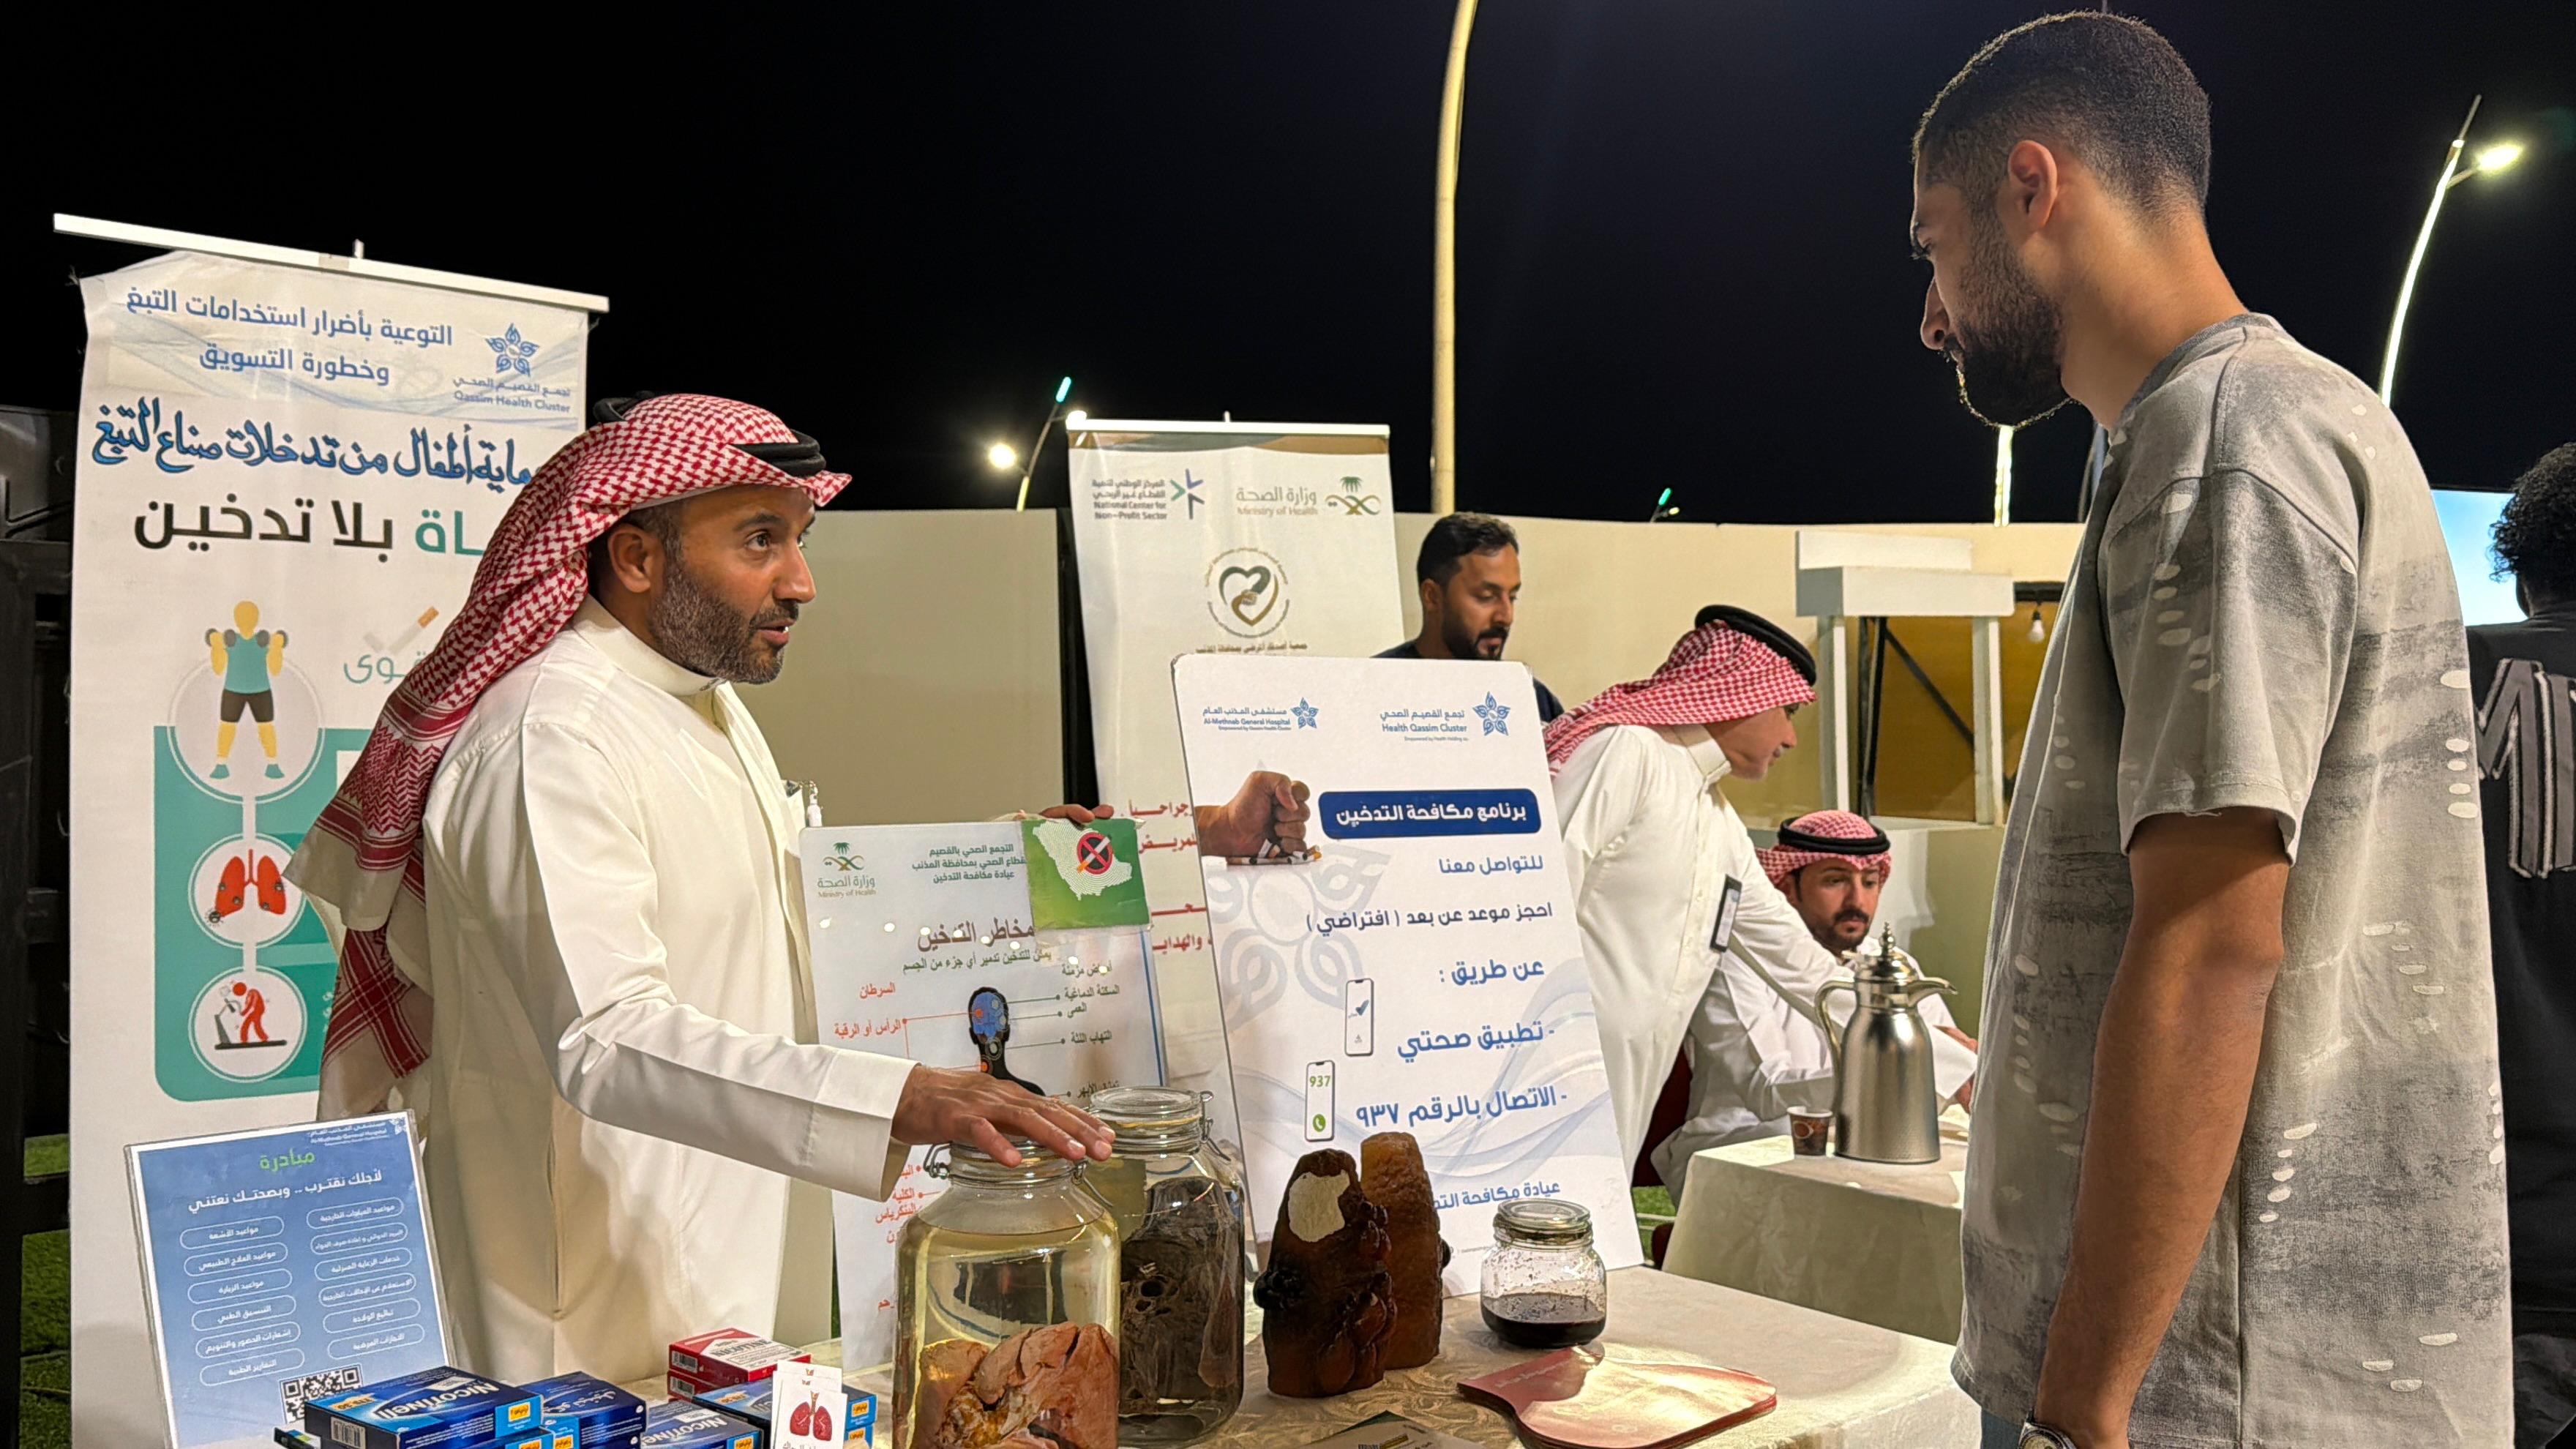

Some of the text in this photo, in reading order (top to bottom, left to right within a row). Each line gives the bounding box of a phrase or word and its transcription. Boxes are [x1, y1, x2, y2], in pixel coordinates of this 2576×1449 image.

[127, 287, 452, 348] التوعية بأضرار استخدامات التبغ
[199, 342, 389, 386] وخطورة التسويق
[454, 390, 571, 413] Qassim Health Cluster
[92, 397, 160, 465] التبغ
[155, 411, 222, 473] صناع
[225, 419, 340, 468] تدخلات
[339, 441, 388, 475] من
[472, 438, 532, 494] ماية
[1236, 486, 1317, 506] وزارة الصحة
[1142, 512, 1167, 520] Sector
[1238, 506, 1318, 517] Ministry of Health
[135, 493, 315, 551] تدخين
[332, 500, 393, 563] بلا
[1380, 708, 1465, 722] تجمع القصيم الصحي
[1382, 723, 1467, 733] Health Qassim Cluster
[1336, 802, 1527, 828] برنامج مكافحة التدخين
[929, 844, 1014, 858] التجمع الصحي بالقصيم
[912, 859, 940, 869] المذنب
[943, 858, 977, 868] بمحافظة
[979, 857, 1004, 868] الصحي
[1439, 855, 1543, 876] للتواصل معنا
[817, 876, 875, 888] وزارة الصحة
[933, 872, 961, 883] التدخين
[818, 889, 844, 899] Ministry
[855, 888, 876, 896] Health
[1407, 910, 1434, 926] بعد
[1437, 908, 1463, 926] عن
[1468, 907, 1510, 924] موعد
[1516, 902, 1553, 922] احجز
[984, 916, 1035, 947] مخاطر
[1317, 910, 1390, 937] افتراضي
[903, 957, 928, 976] الجسم
[931, 959, 943, 971] من
[946, 959, 963, 970] جزء
[1451, 959, 1507, 985] طريق
[1513, 960, 1545, 981] عن
[860, 981, 896, 999] السرطان
[834, 1017, 902, 1039] الرأس أو الرقبة
[1477, 1020, 1543, 1050] تطبيق
[1397, 1030, 1472, 1063] صحتي
[1309, 1075, 1331, 1088] 937
[1407, 1095, 1480, 1127] بالرقم
[1486, 1085, 1557, 1118] الاتصال
[1356, 1103, 1399, 1128] ٩٣٧
[260, 1148, 315, 1172] مبادرة
[304, 1176, 346, 1194] نقترب
[348, 1168, 383, 1186] لأجلك
[233, 1186, 291, 1204] وبصحتك
[1461, 1186, 1519, 1205] مكافحة
[1524, 1180, 1560, 1197] عيادة
[188, 1193, 229, 1213] نعتني
